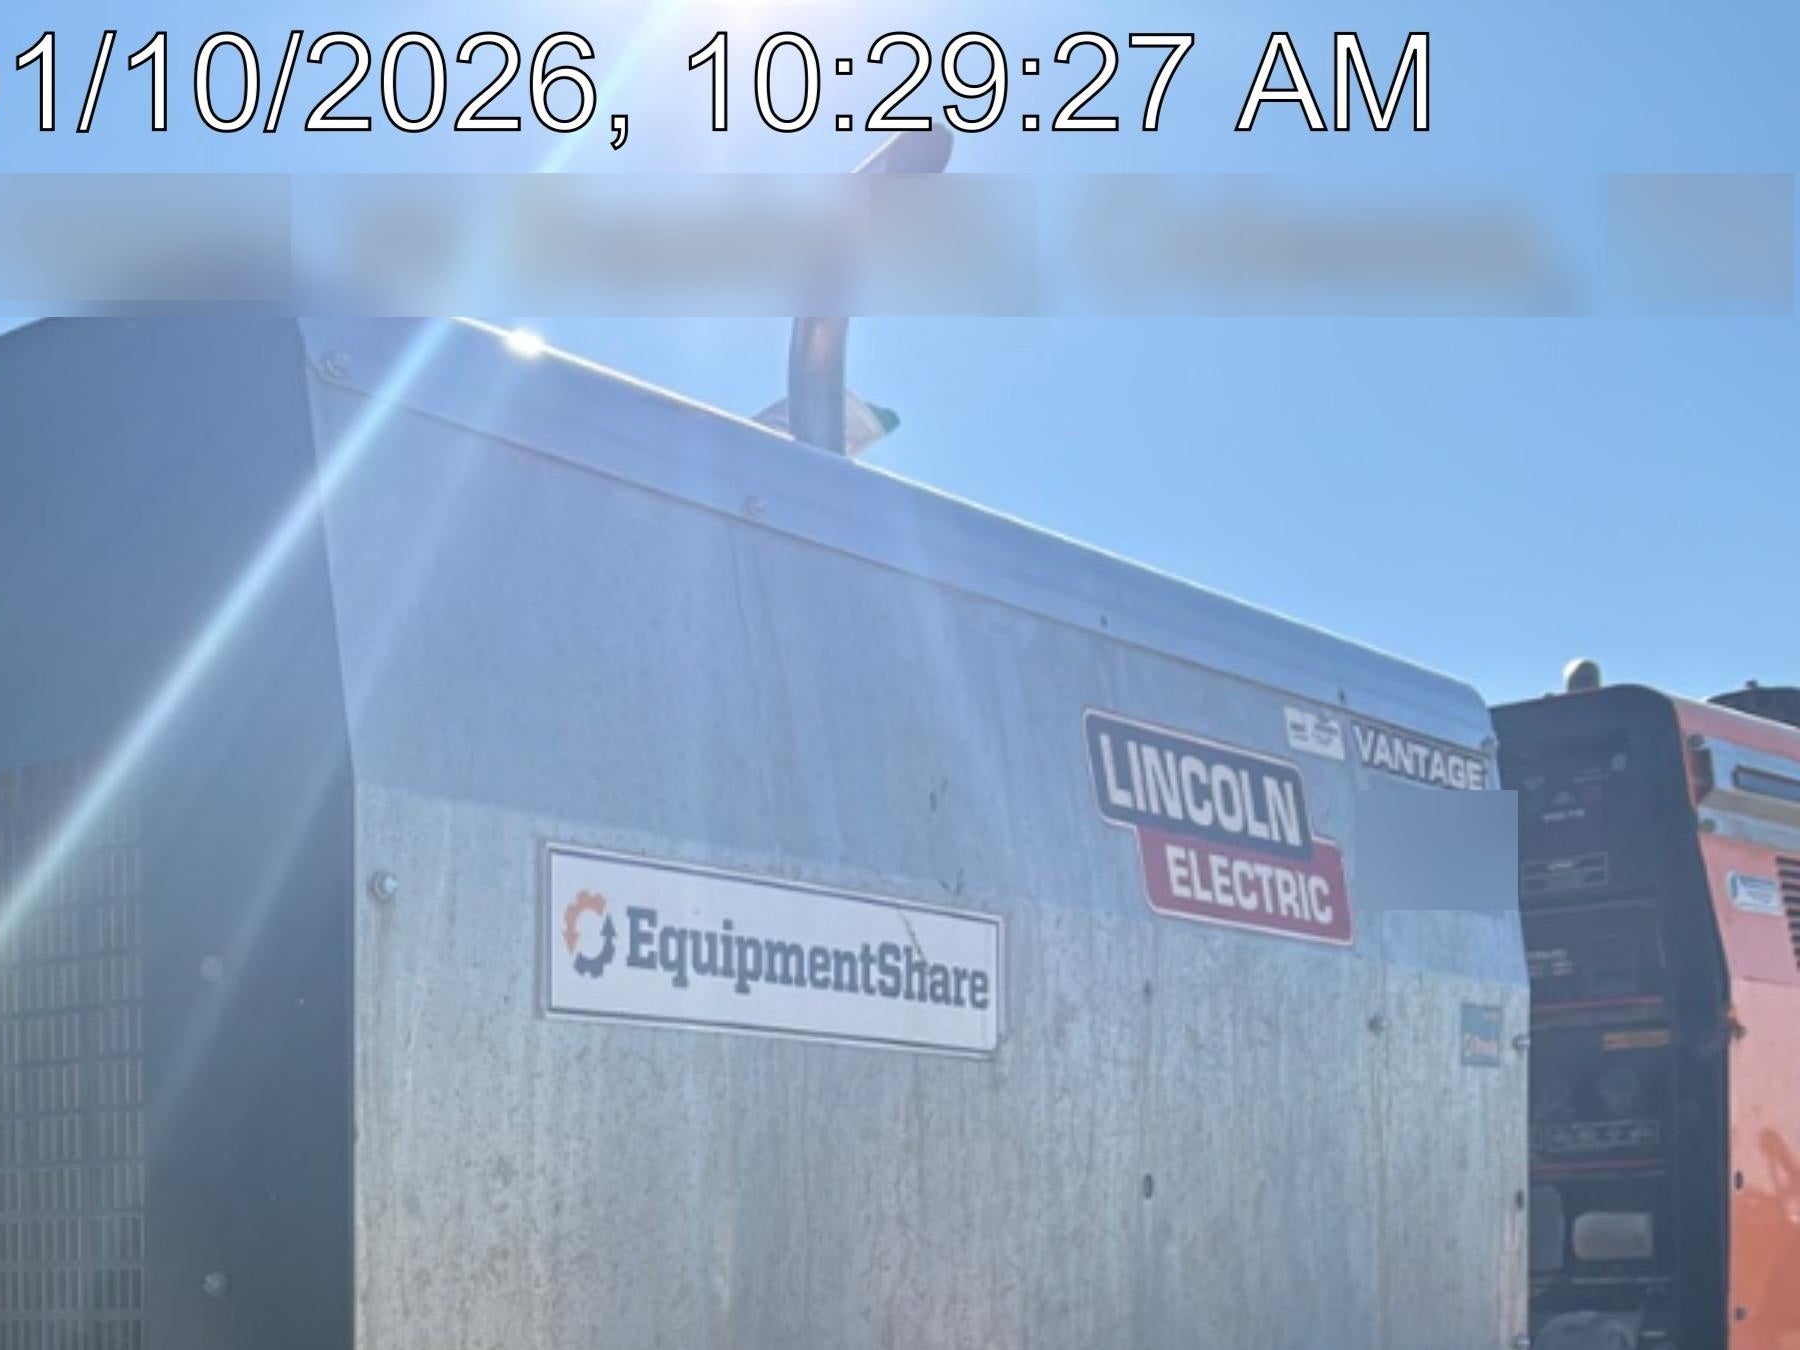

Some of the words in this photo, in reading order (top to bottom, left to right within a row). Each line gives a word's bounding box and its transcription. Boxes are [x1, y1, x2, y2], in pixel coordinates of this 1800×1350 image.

[1099, 733, 1303, 847] LINCOLN
[1352, 725, 1484, 790] VANTAGE
[1165, 844, 1334, 925] ELECTRIC
[625, 905, 990, 1010] EquipmentShare
